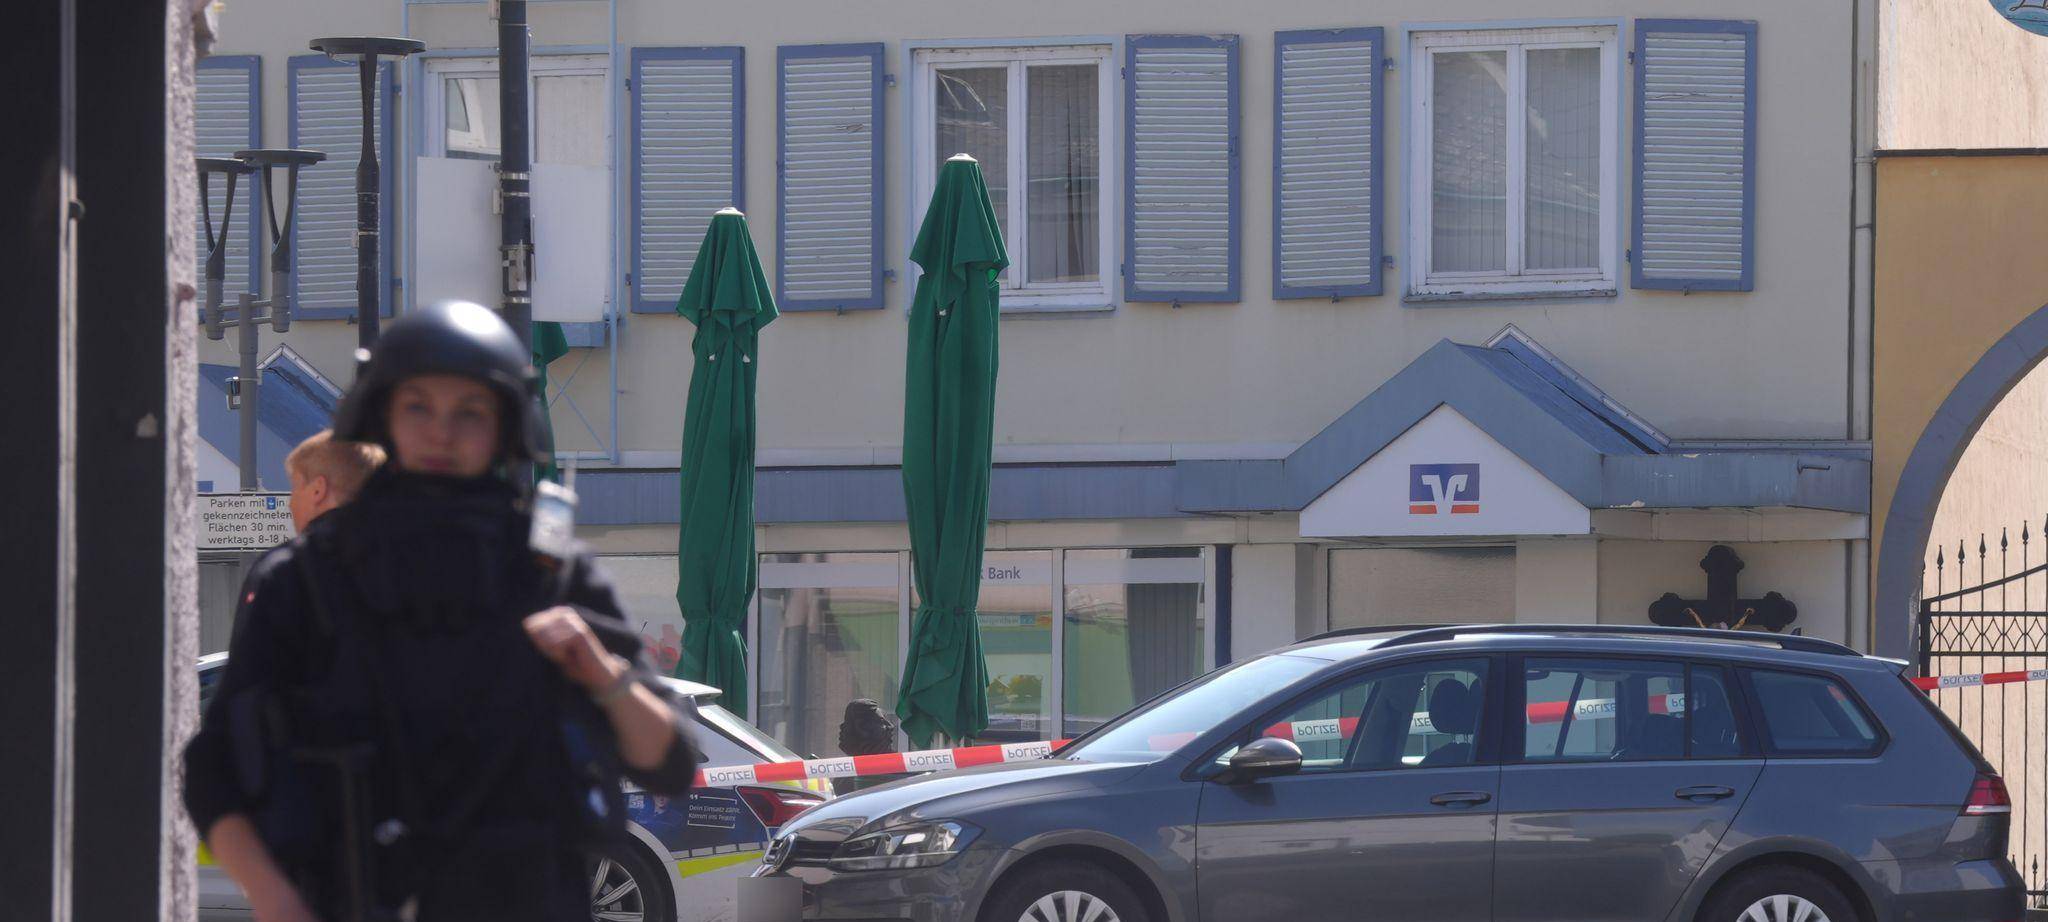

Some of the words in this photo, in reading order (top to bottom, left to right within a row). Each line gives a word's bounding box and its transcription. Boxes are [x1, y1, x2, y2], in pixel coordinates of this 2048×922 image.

[210, 498, 246, 508] Parken
[250, 498, 265, 508] mit
[276, 499, 285, 507] in
[203, 510, 292, 522] gekennzeichneten
[208, 522, 247, 532] Flächen
[250, 522, 263, 531] 30
[267, 523, 288, 531] min.
[208, 535, 255, 545] werktags
[258, 534, 279, 544] 8-18
[988, 566, 1021, 579] Bank
